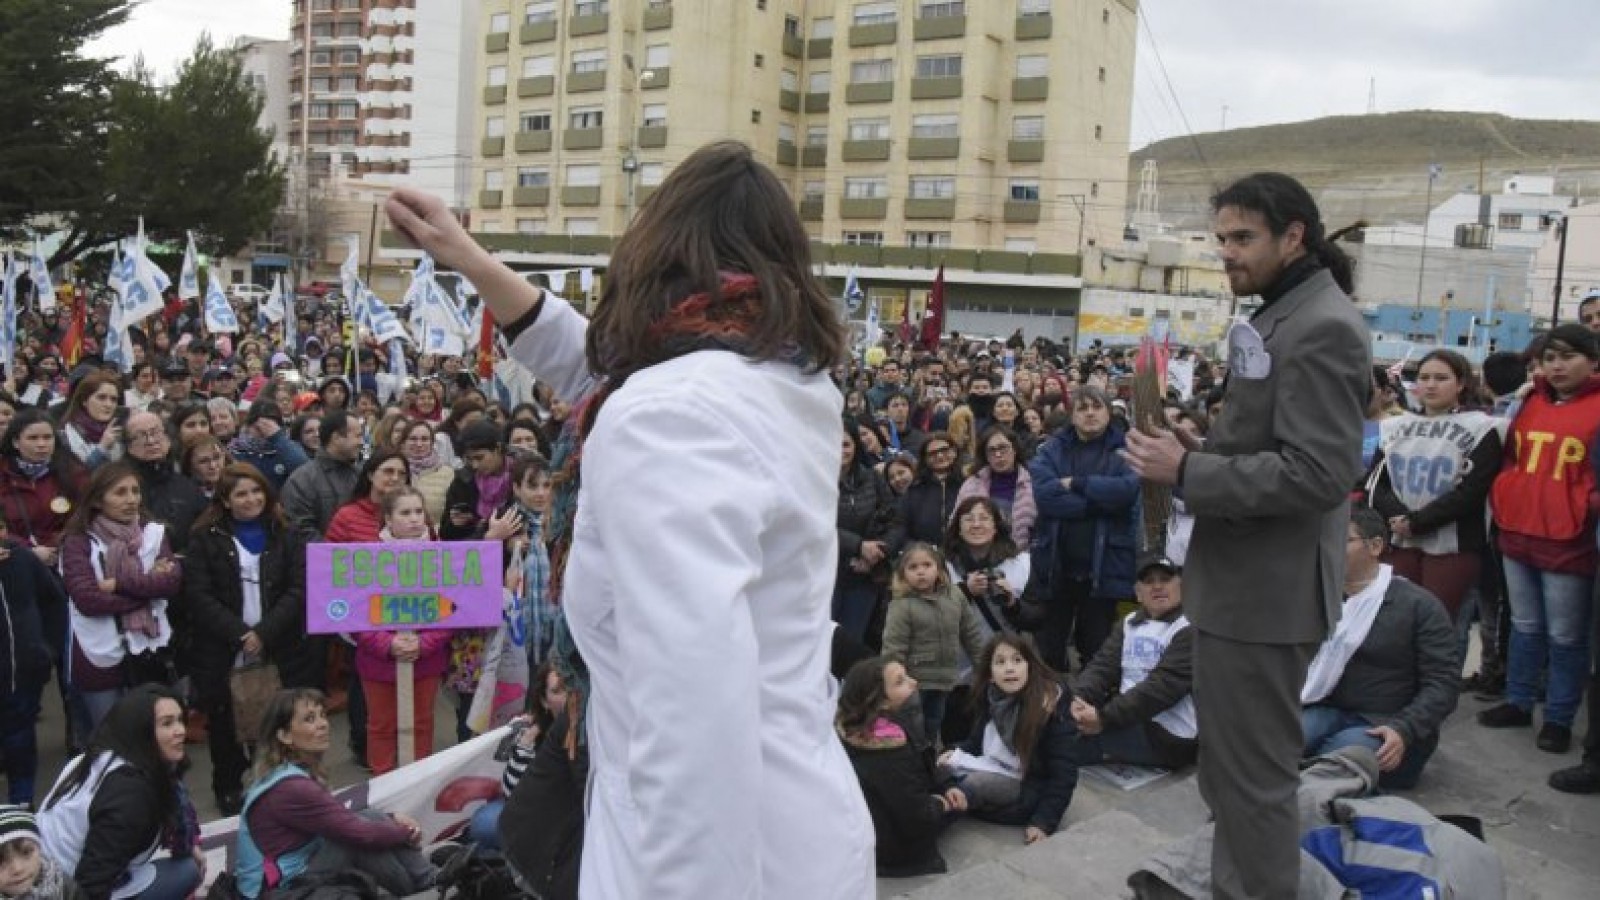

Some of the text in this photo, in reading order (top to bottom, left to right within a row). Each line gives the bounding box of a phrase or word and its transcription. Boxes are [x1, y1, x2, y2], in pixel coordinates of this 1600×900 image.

[1515, 431, 1586, 480] TP
[332, 549, 482, 588] ESCUELA
[386, 595, 437, 624] 146
